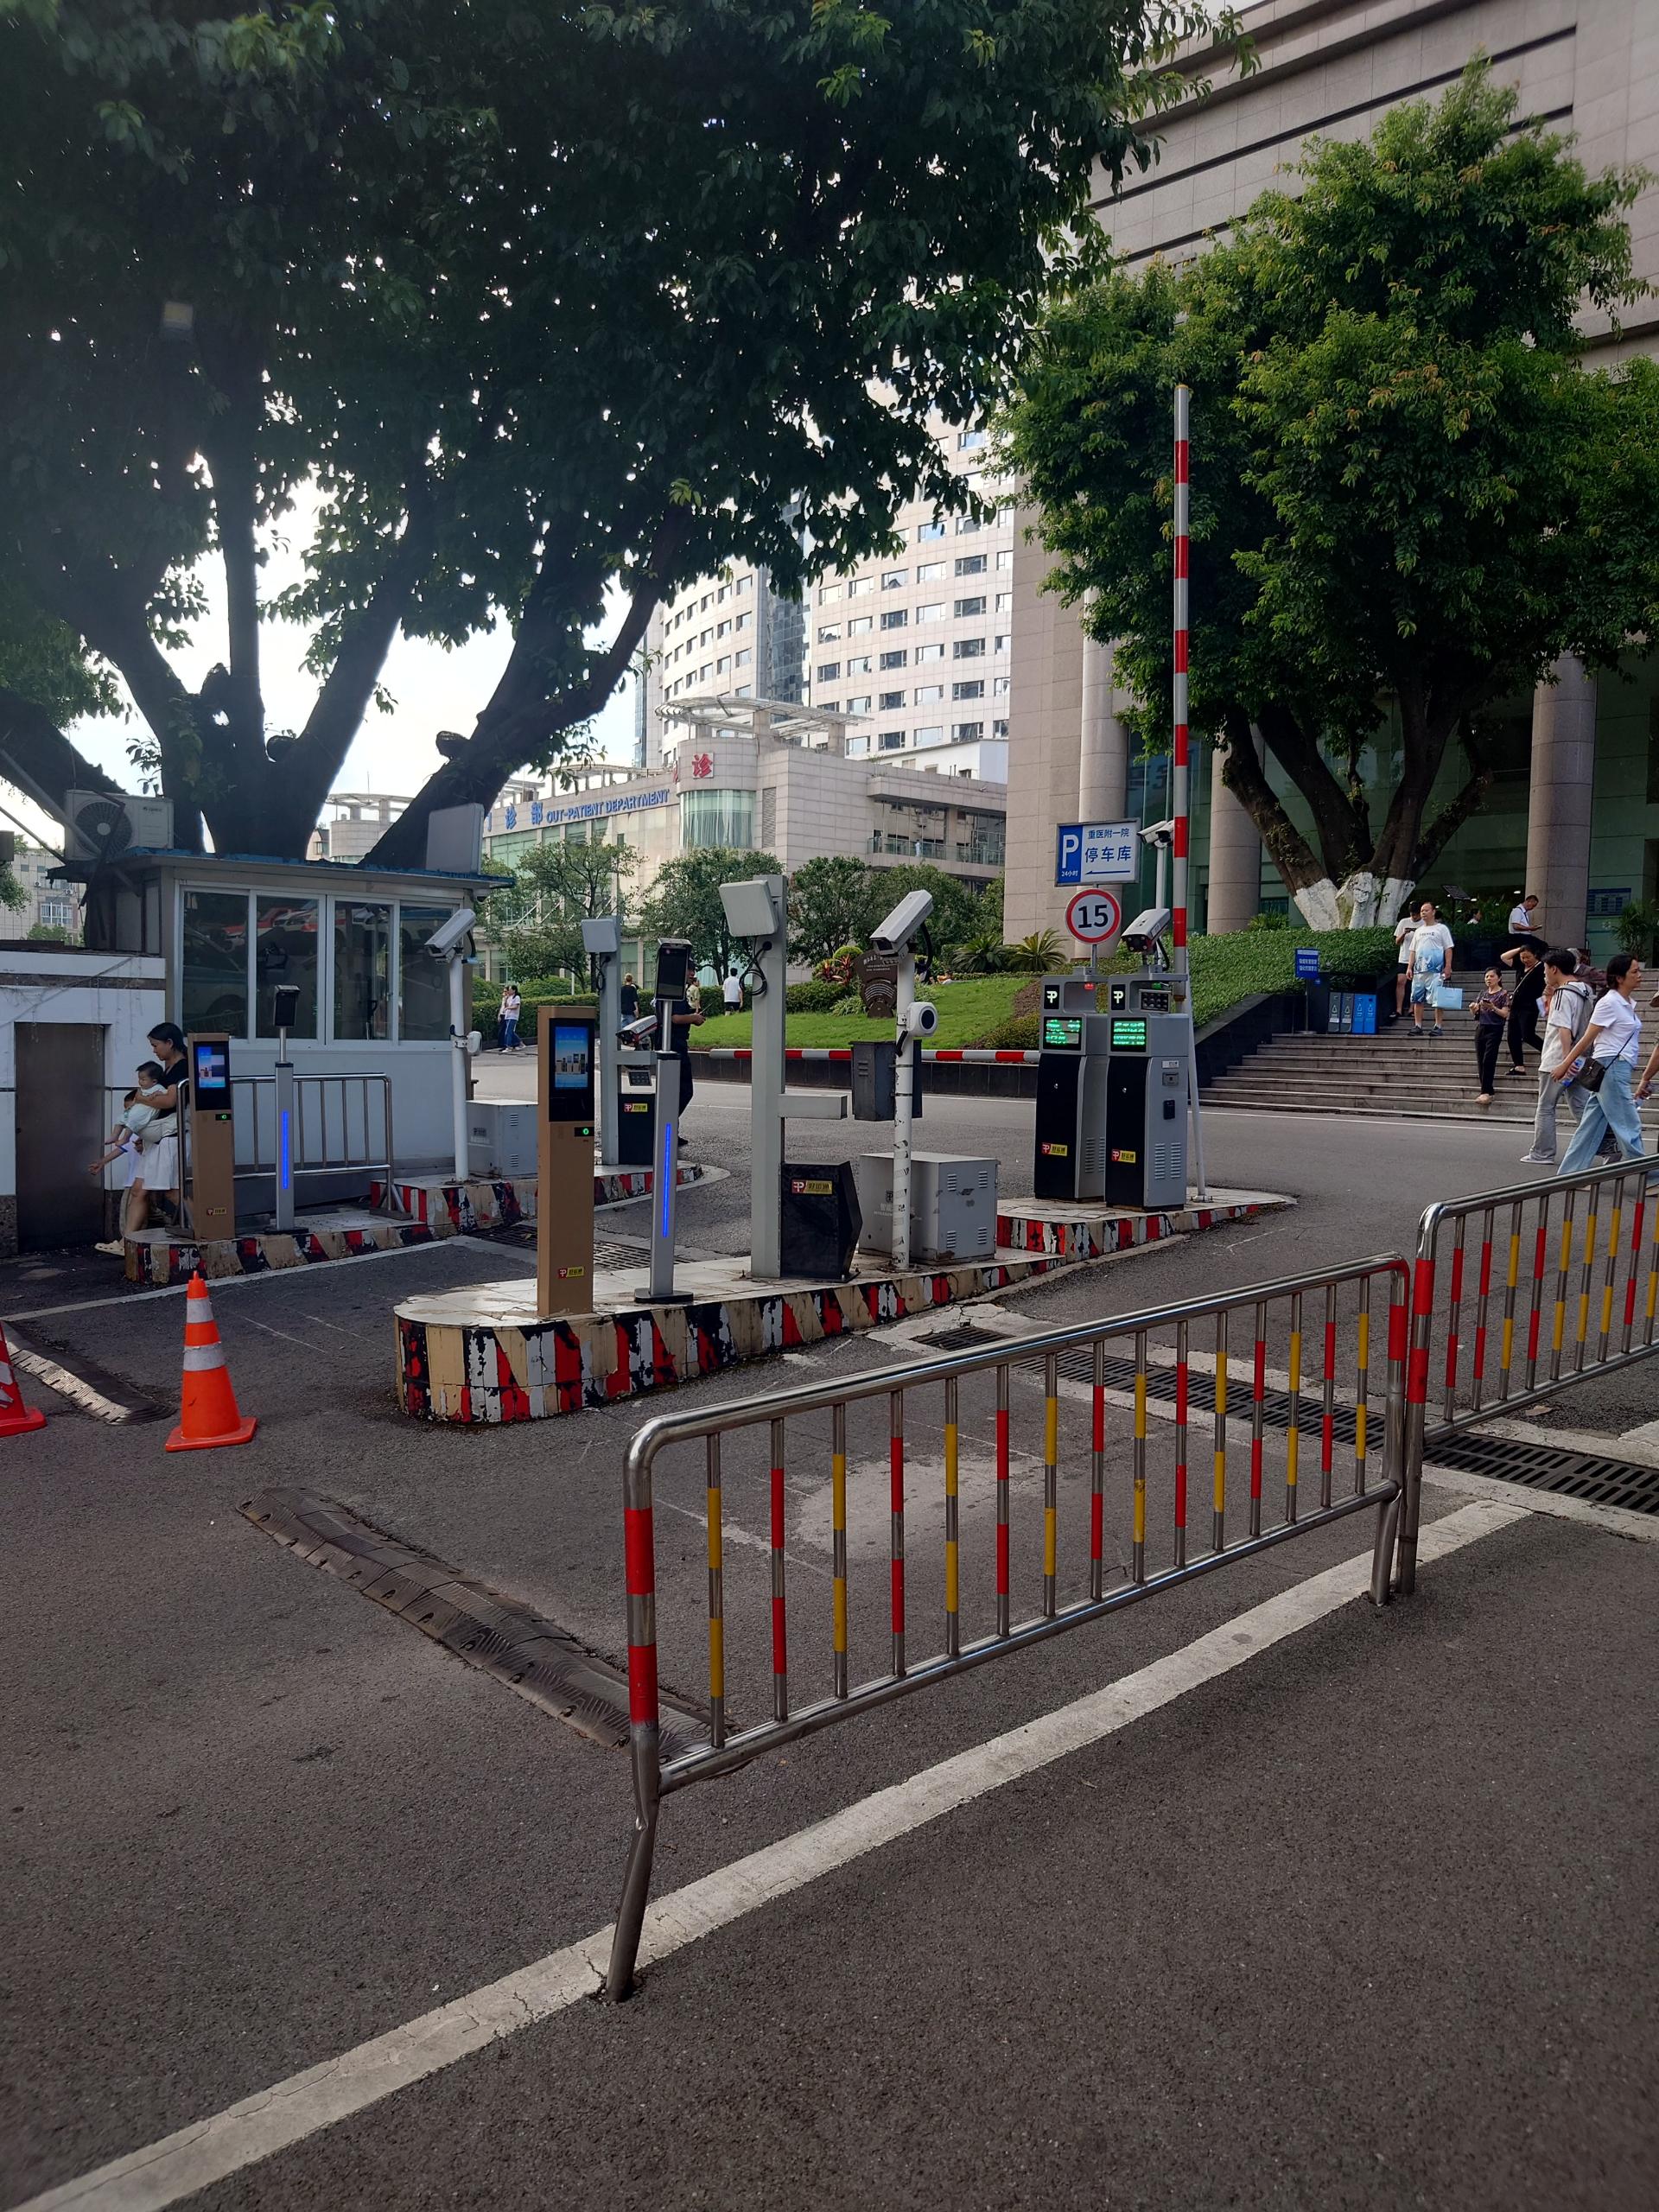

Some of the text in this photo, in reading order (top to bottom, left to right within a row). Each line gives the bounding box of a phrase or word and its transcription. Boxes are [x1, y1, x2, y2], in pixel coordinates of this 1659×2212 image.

[546, 788, 670, 823] OUT-PATIENT DEPARTMENT
[1087, 828, 1130, 840] 重医附一院
[1062, 834, 1079, 869] P
[1084, 845, 1132, 863] 停车库
[1077, 904, 1109, 929] 15
